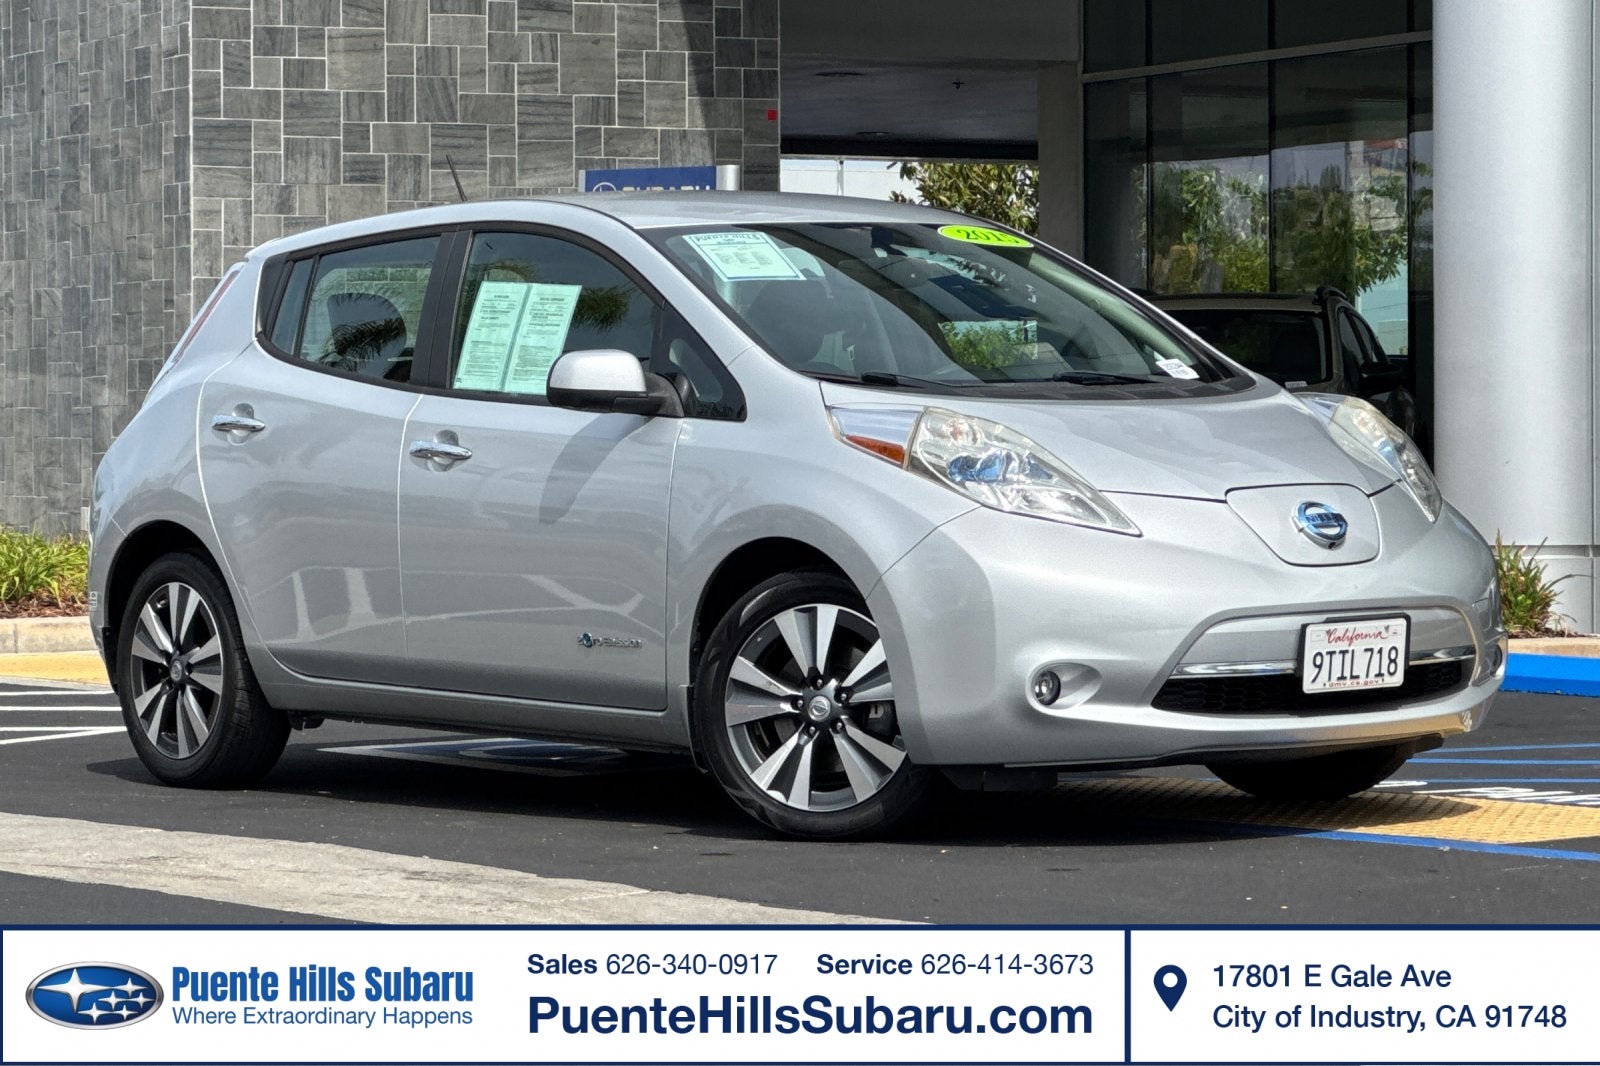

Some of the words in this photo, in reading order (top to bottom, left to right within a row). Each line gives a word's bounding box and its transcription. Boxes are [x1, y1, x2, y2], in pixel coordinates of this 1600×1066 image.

[1327, 627, 1389, 648] California
[1311, 645, 1399, 684] 9TIL718
[1328, 679, 1379, 688] dmv.ca.gov
